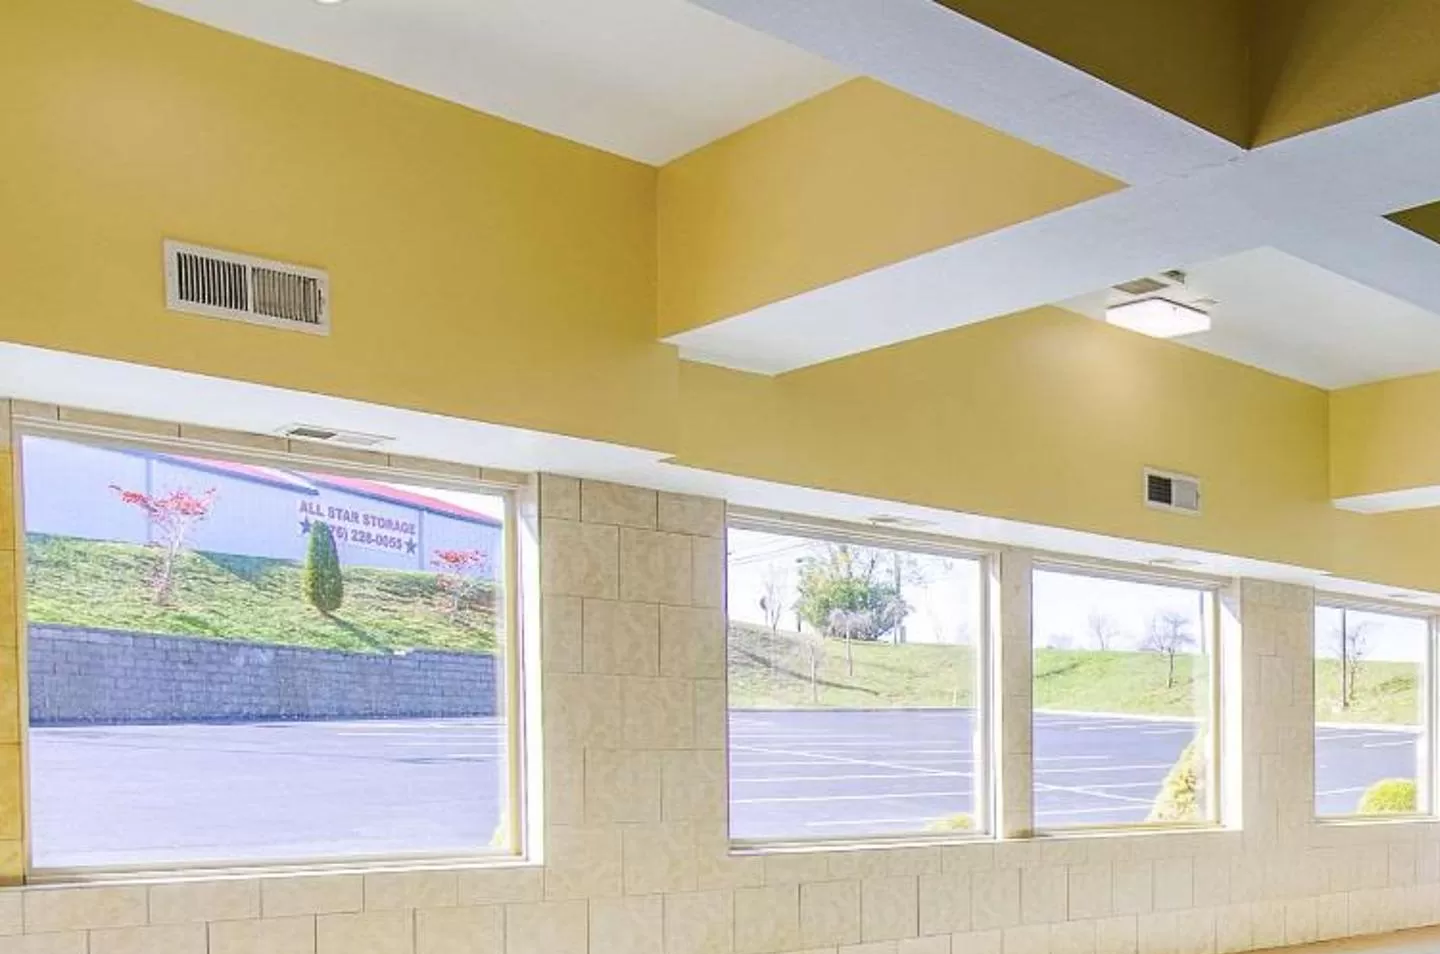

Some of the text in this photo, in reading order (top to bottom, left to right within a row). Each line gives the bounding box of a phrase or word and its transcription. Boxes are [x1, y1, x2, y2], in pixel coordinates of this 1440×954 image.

[299, 500, 416, 535] ALL STAR STORAGE
